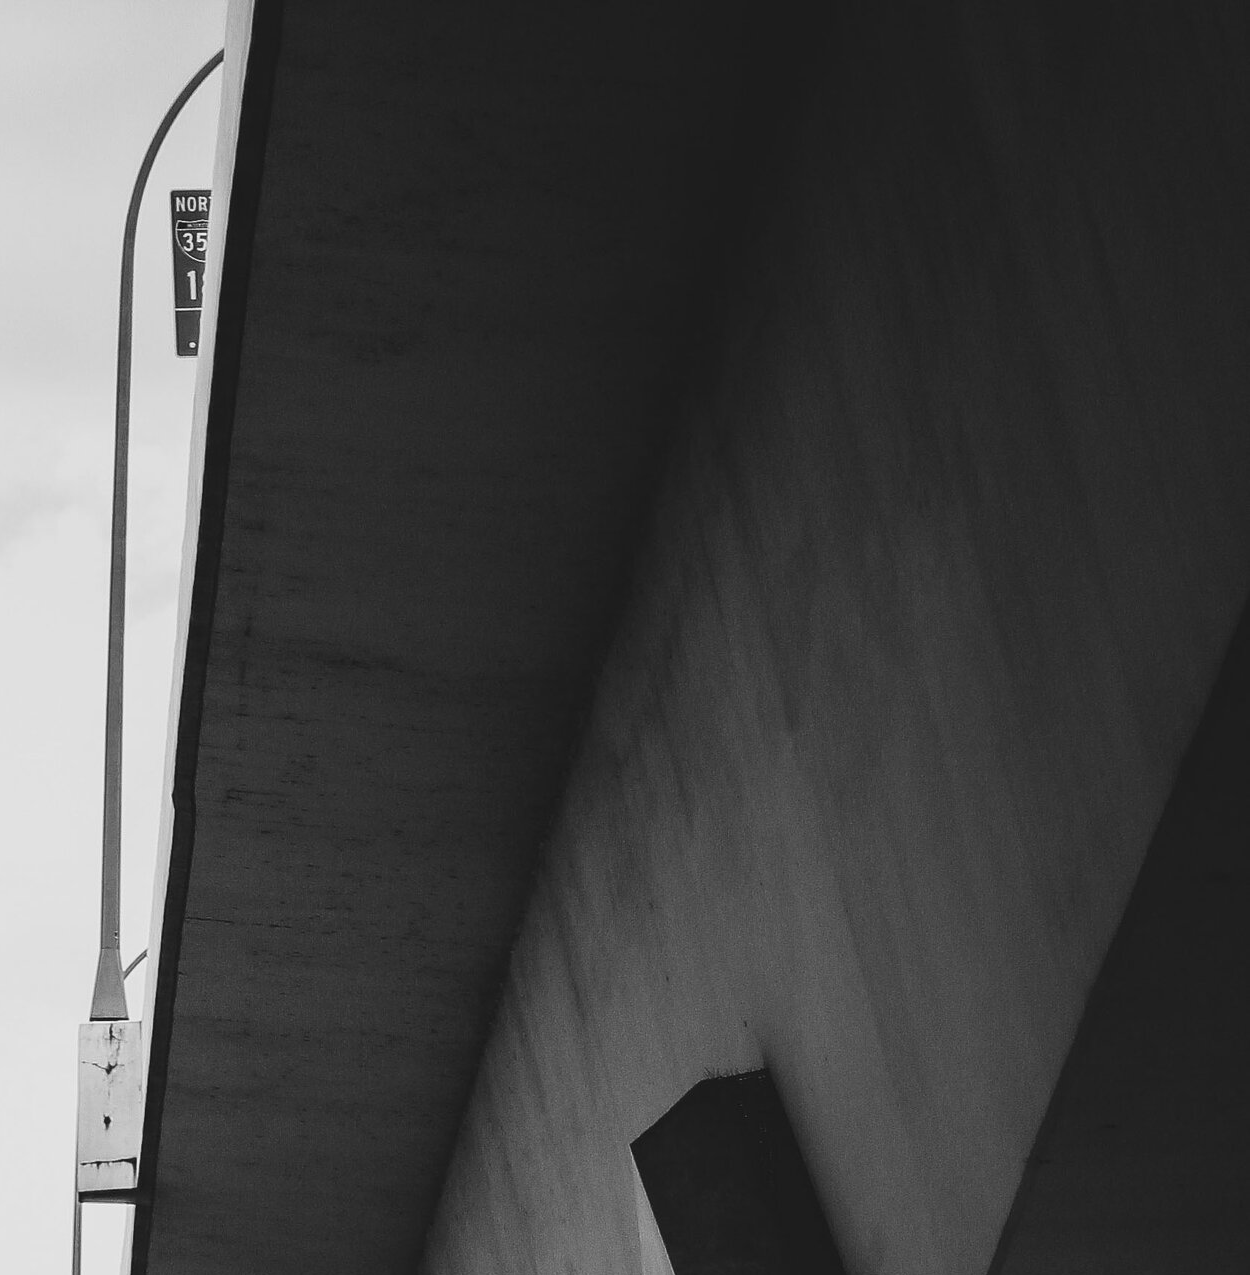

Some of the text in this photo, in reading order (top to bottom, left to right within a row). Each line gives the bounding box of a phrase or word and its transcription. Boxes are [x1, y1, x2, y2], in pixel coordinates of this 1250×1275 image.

[175, 196, 211, 212] NOR
[182, 232, 207, 251] 35
[186, 270, 203, 300] 1
